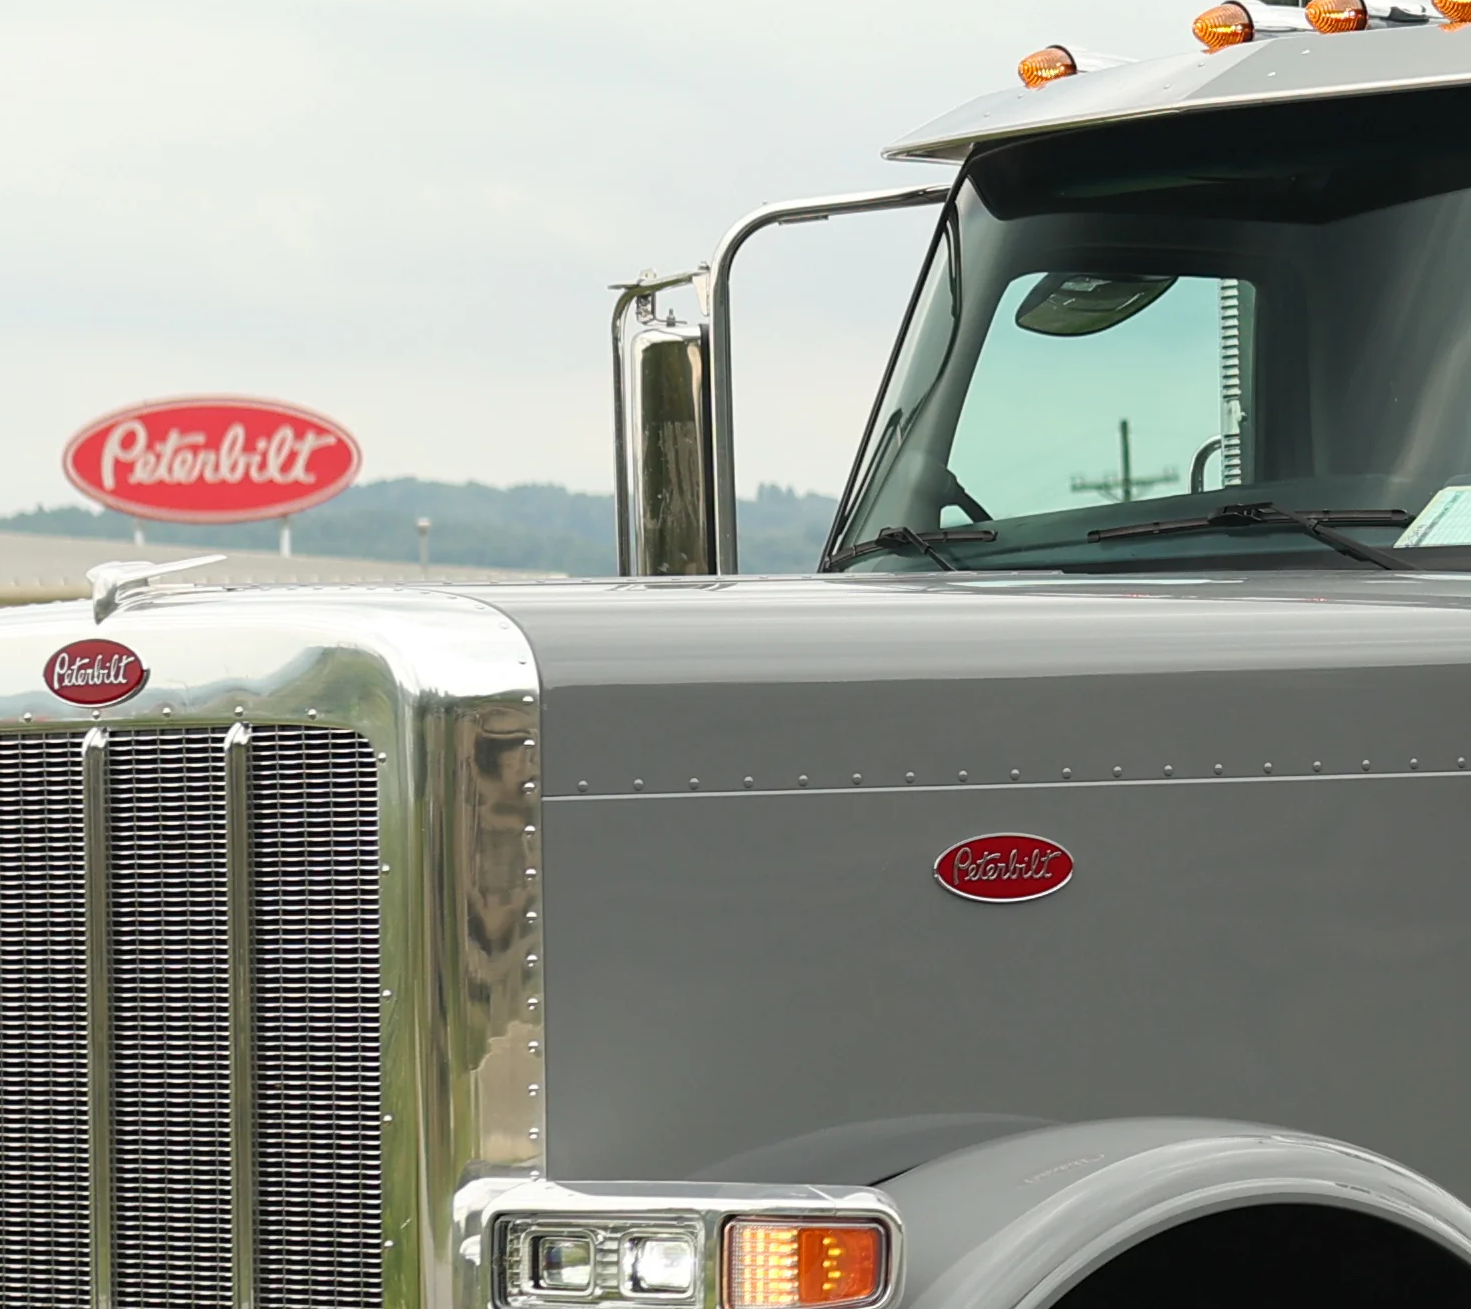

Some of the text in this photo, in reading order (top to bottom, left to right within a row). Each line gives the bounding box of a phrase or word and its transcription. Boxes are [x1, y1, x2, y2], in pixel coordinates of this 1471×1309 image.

[100, 419, 338, 492] Peterbilt
[53, 652, 136, 690] Peterbilt
[952, 846, 1063, 886] Peterbilt
